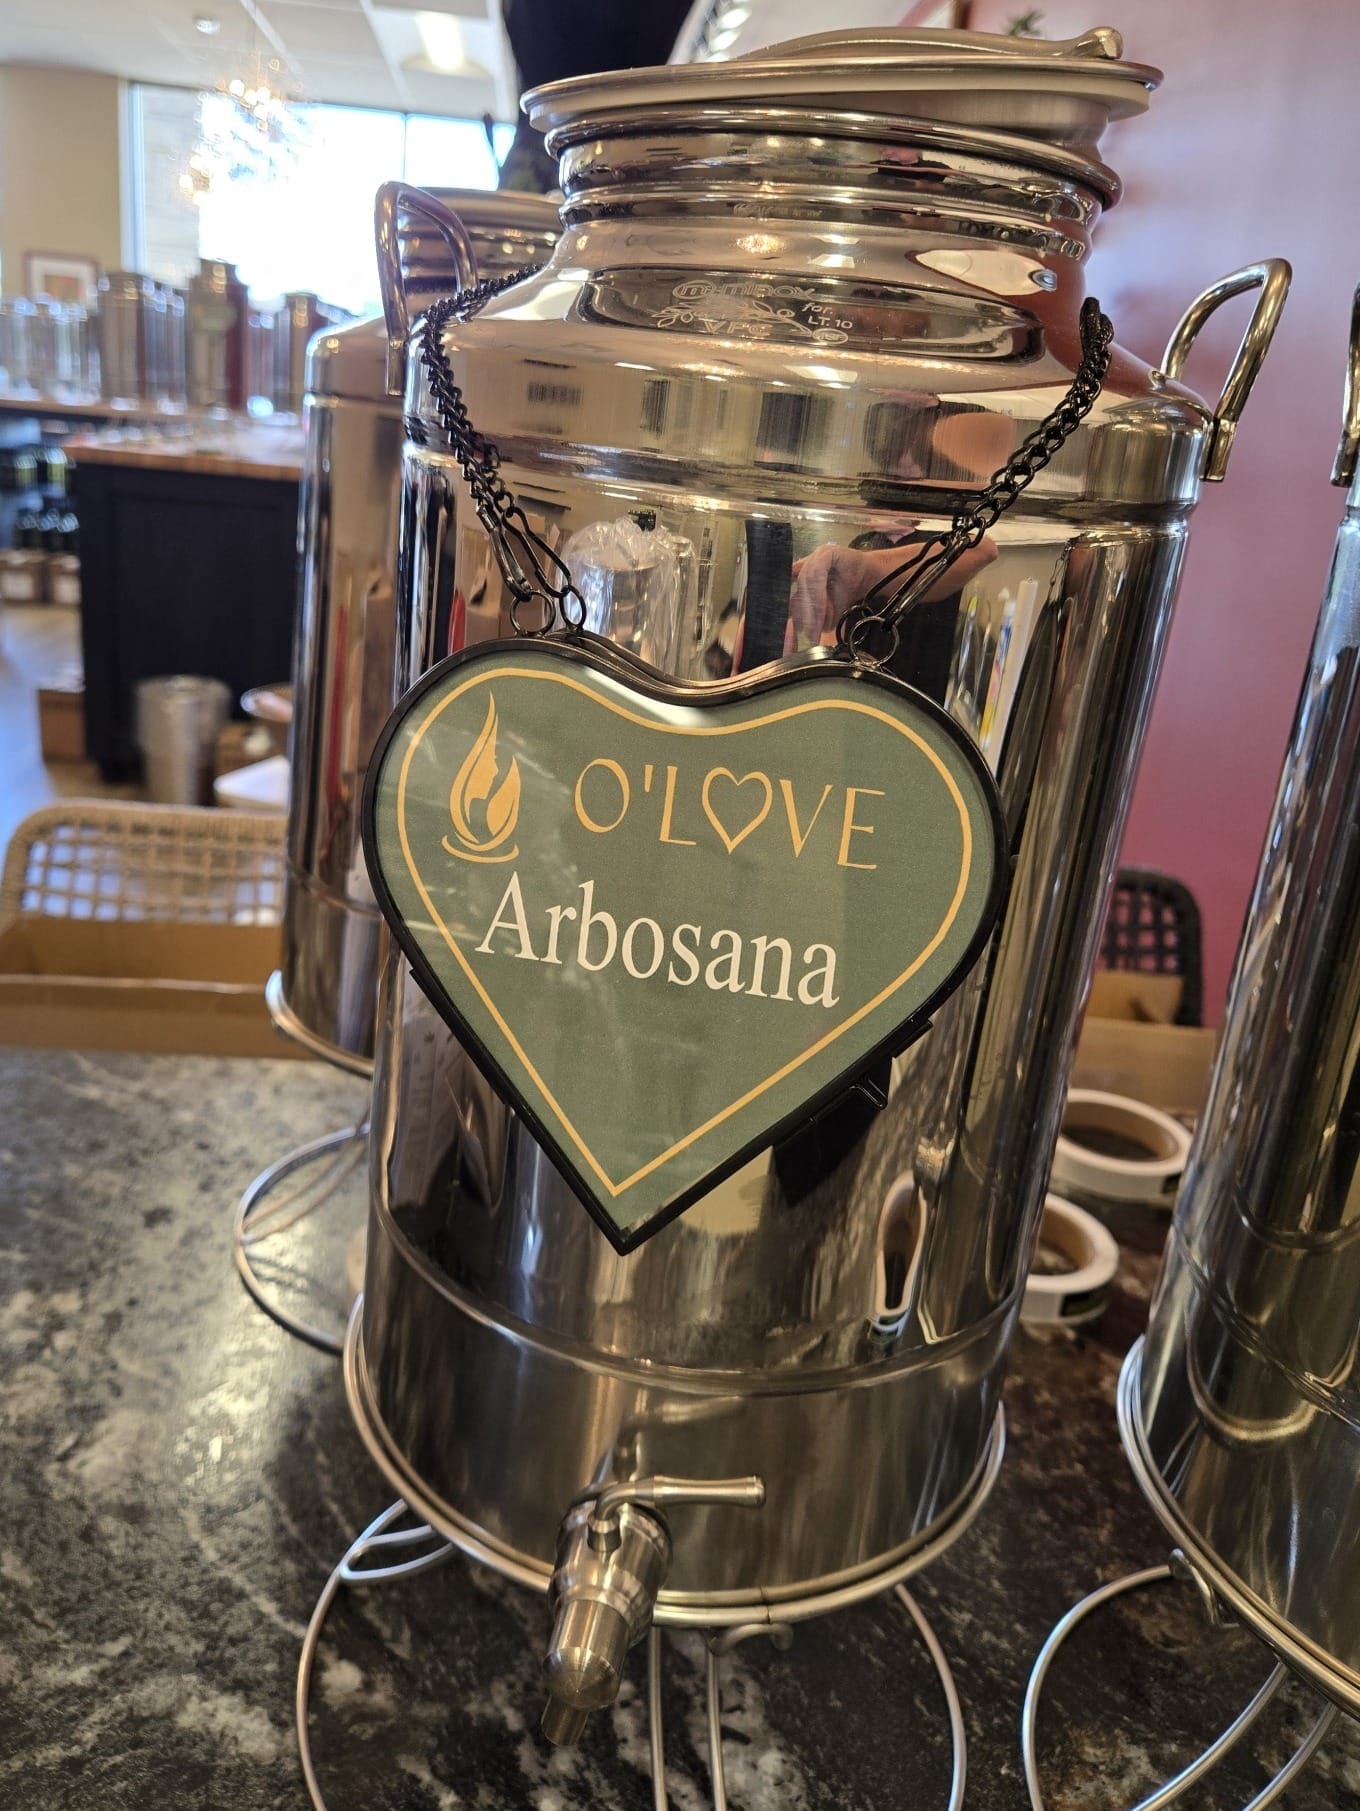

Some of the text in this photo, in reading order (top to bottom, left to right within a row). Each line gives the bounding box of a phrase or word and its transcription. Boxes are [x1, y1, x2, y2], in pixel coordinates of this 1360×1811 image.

[807, 315, 853, 329] LT. 10
[475, 872, 840, 1008] Arbosana
